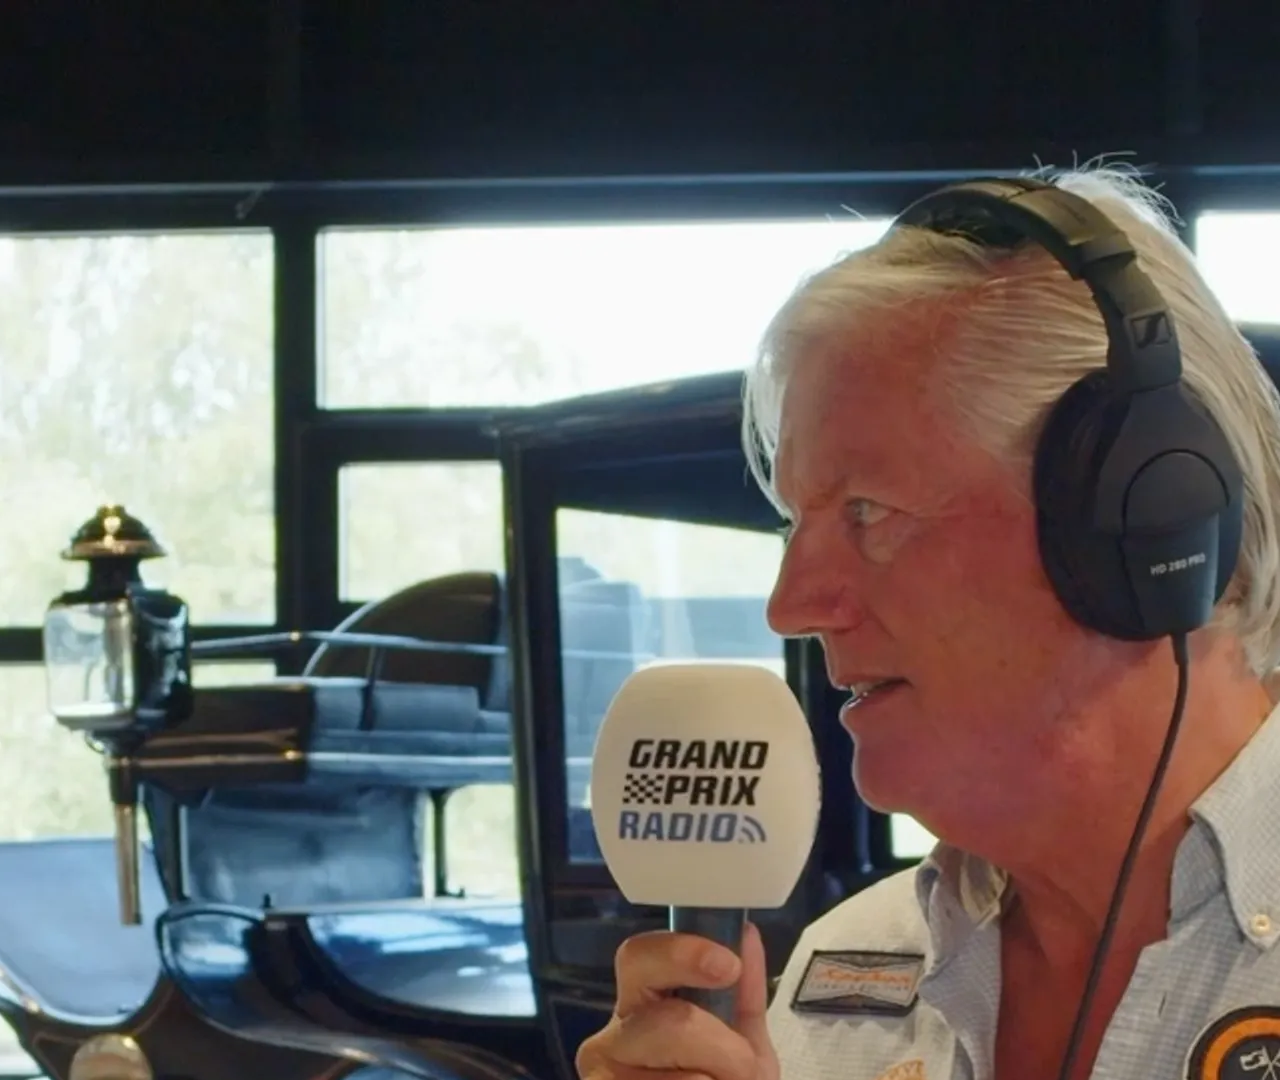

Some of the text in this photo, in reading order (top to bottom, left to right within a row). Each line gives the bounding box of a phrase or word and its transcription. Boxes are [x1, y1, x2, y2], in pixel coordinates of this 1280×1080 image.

[628, 739, 769, 770] GRAND
[664, 775, 761, 806] PRIX
[618, 811, 739, 843] RADIO
